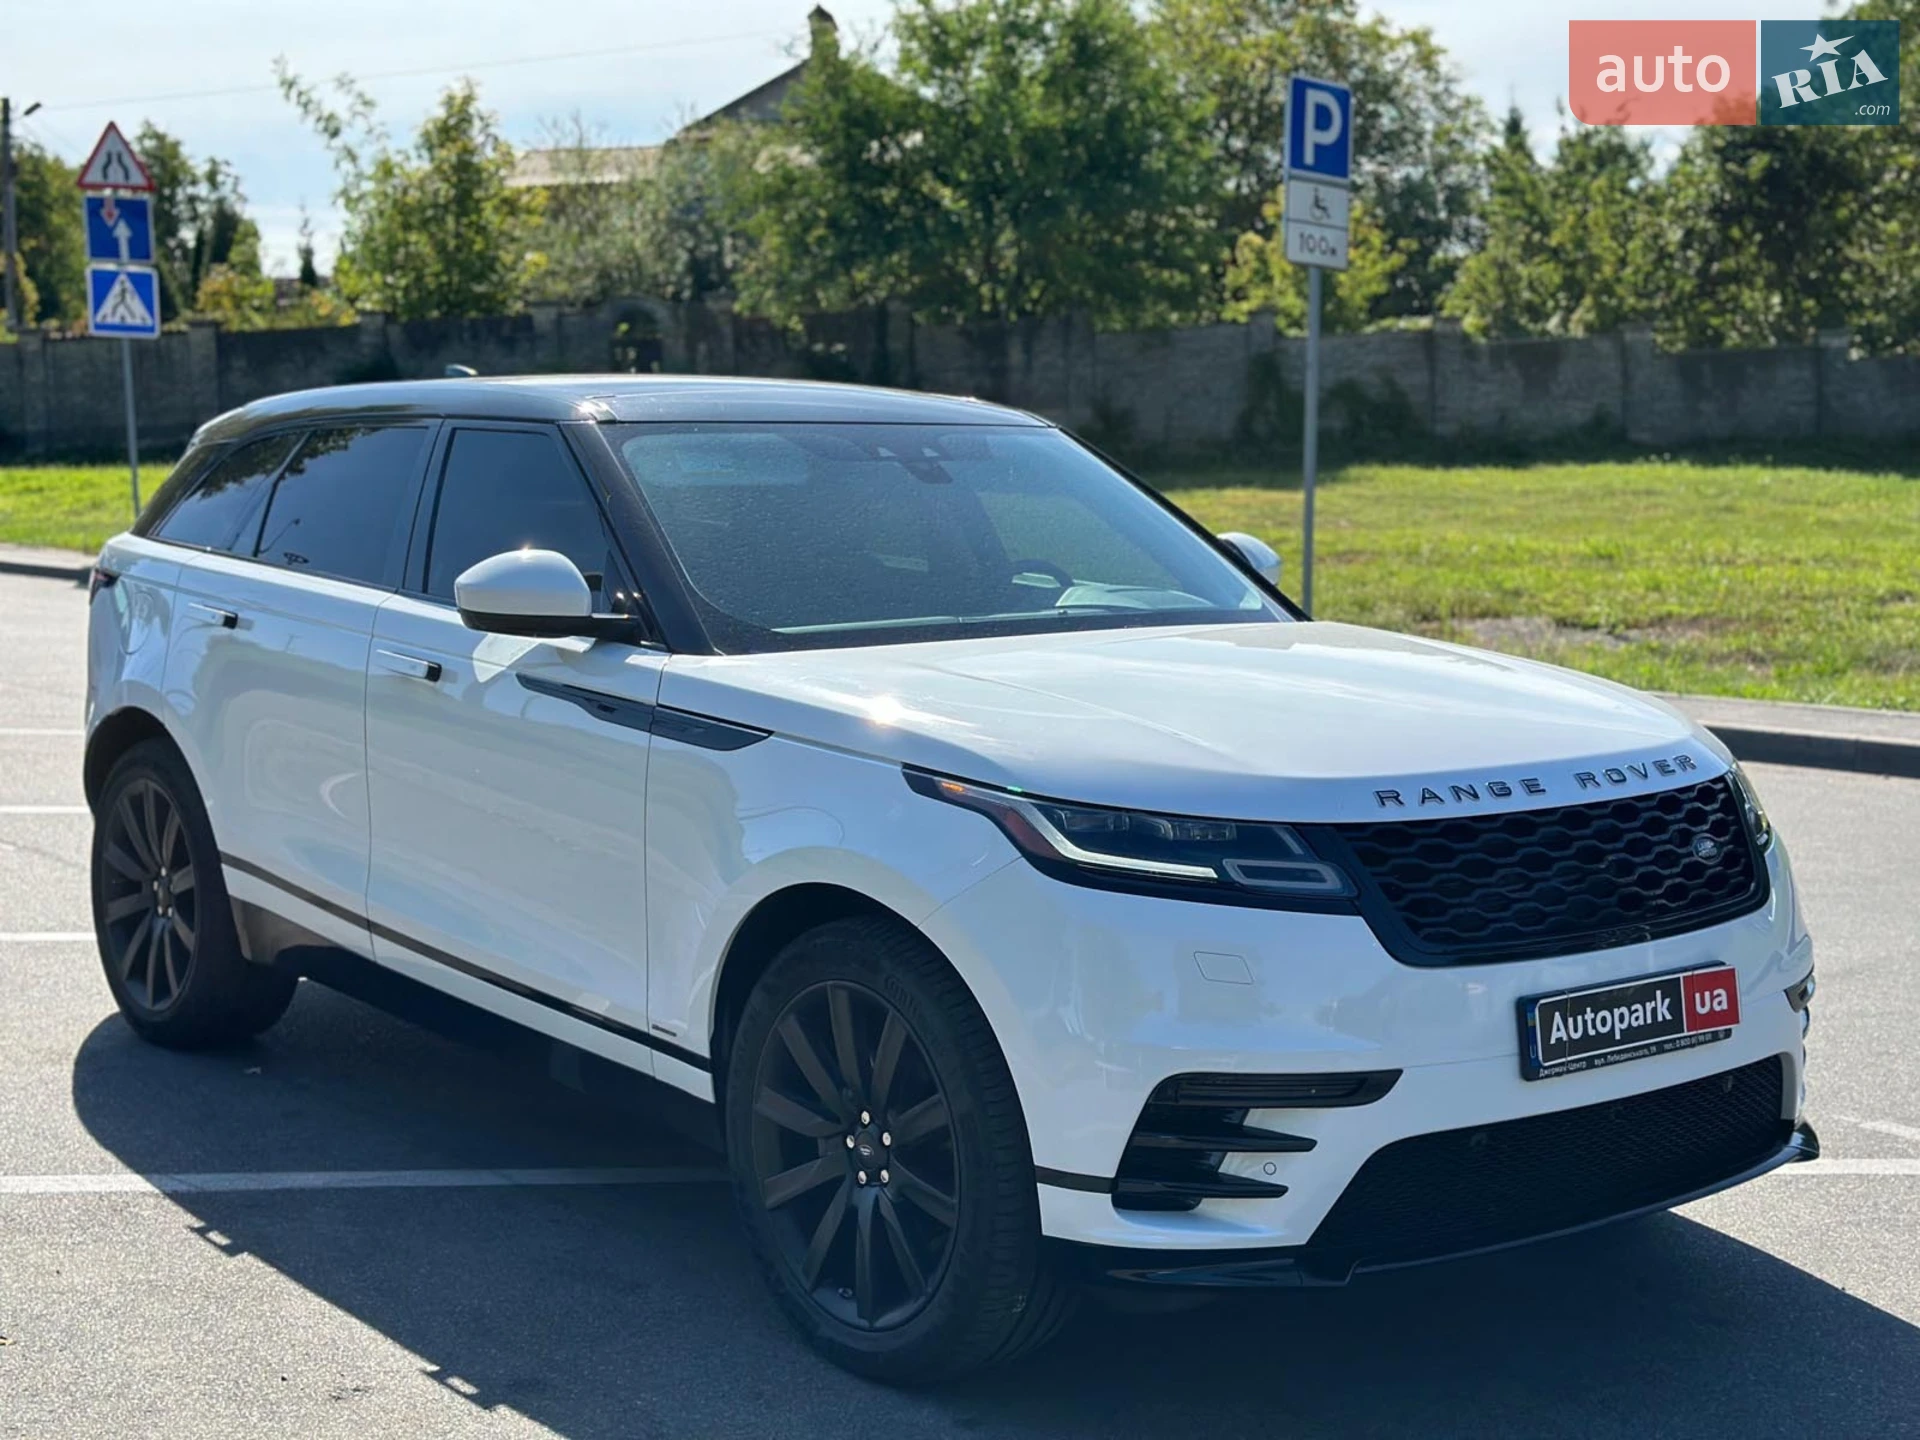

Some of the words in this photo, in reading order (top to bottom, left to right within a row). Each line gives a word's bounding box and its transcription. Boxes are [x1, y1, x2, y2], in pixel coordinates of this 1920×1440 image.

[1304, 88, 1342, 167] P
[1373, 777, 1547, 808] RANGE
[1574, 753, 1698, 790] ROVER
[1549, 989, 1673, 1040] Autopark
[1694, 987, 1728, 1015] ua
